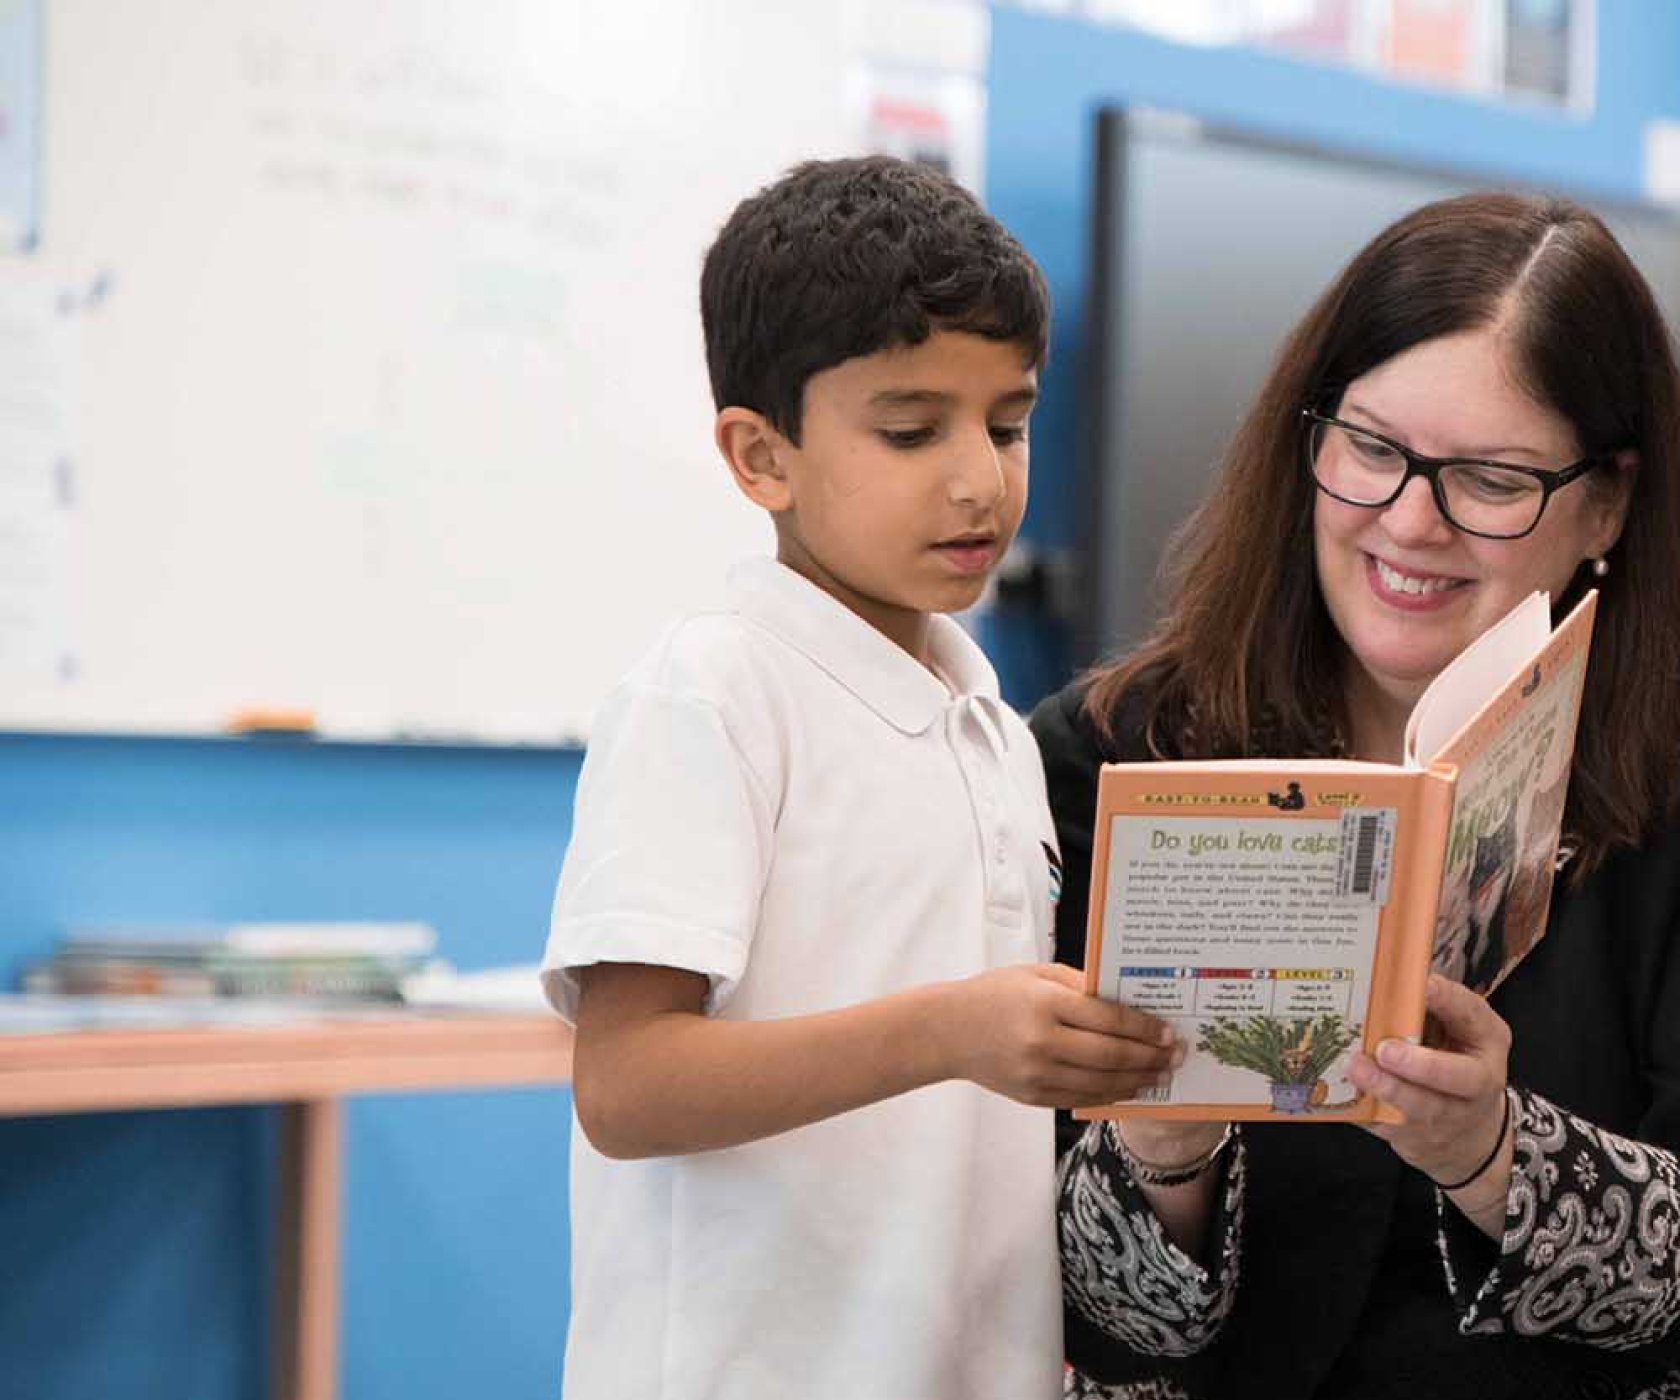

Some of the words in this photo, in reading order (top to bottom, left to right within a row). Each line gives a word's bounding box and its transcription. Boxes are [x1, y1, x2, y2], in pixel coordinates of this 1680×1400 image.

[1151, 830, 1180, 850] Do
[1188, 834, 1229, 855] you
[1236, 831, 1284, 851] love
